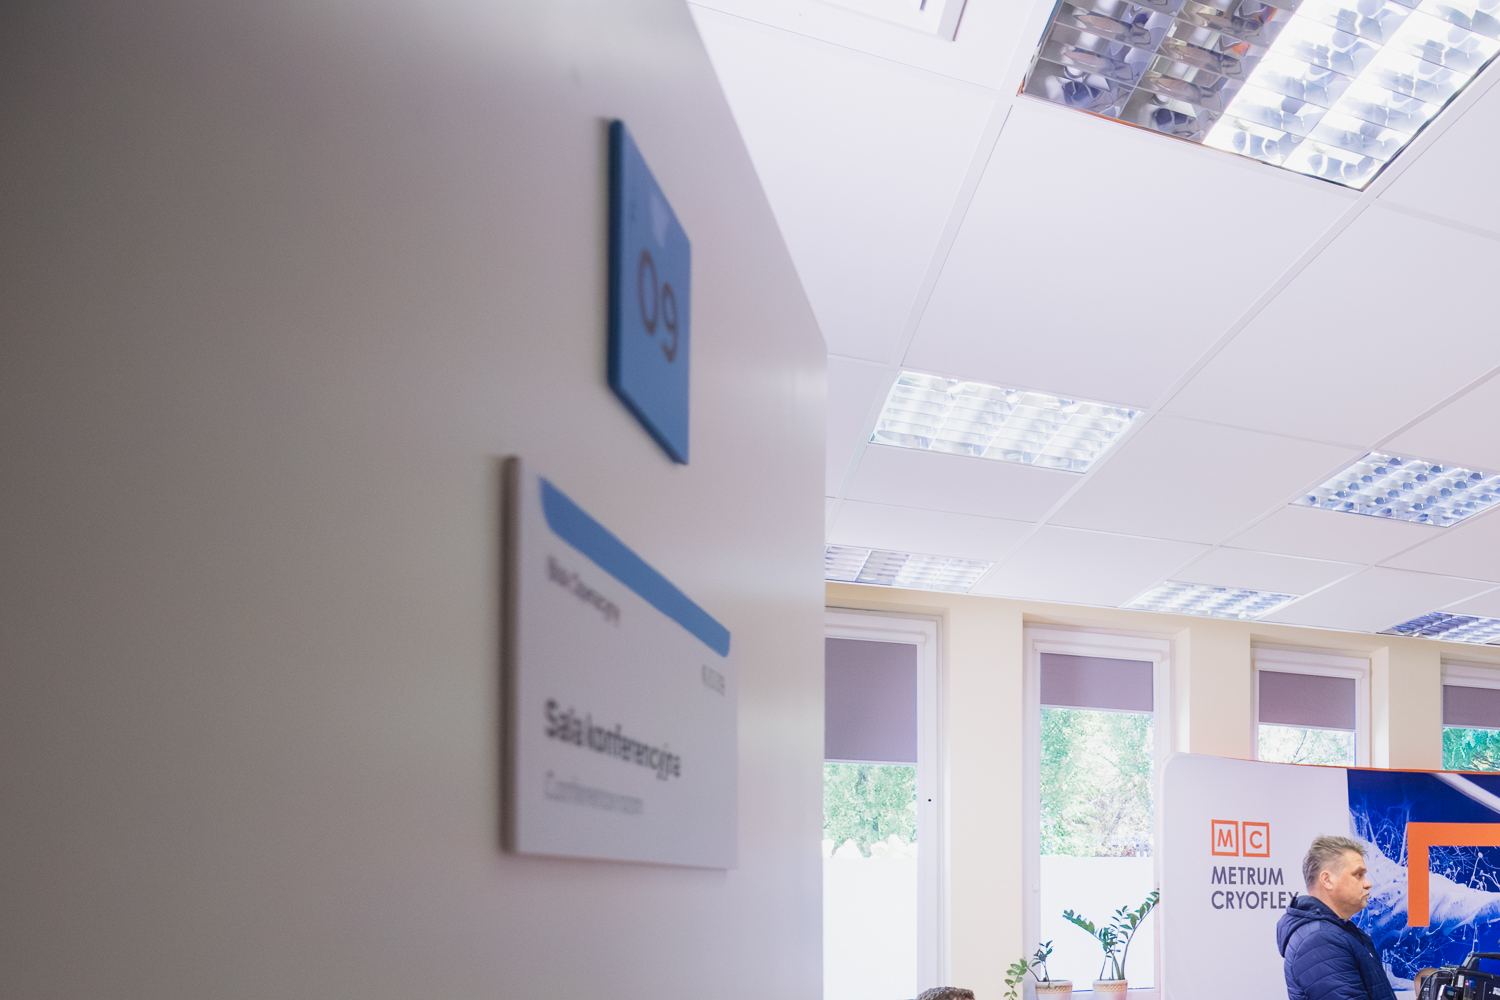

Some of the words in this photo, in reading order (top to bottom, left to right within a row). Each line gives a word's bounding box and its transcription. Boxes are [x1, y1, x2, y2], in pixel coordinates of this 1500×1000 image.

[638, 248, 678, 363] 09
[1217, 828, 1234, 848] M
[1249, 830, 1263, 849] C
[1211, 866, 1284, 886] METRUM
